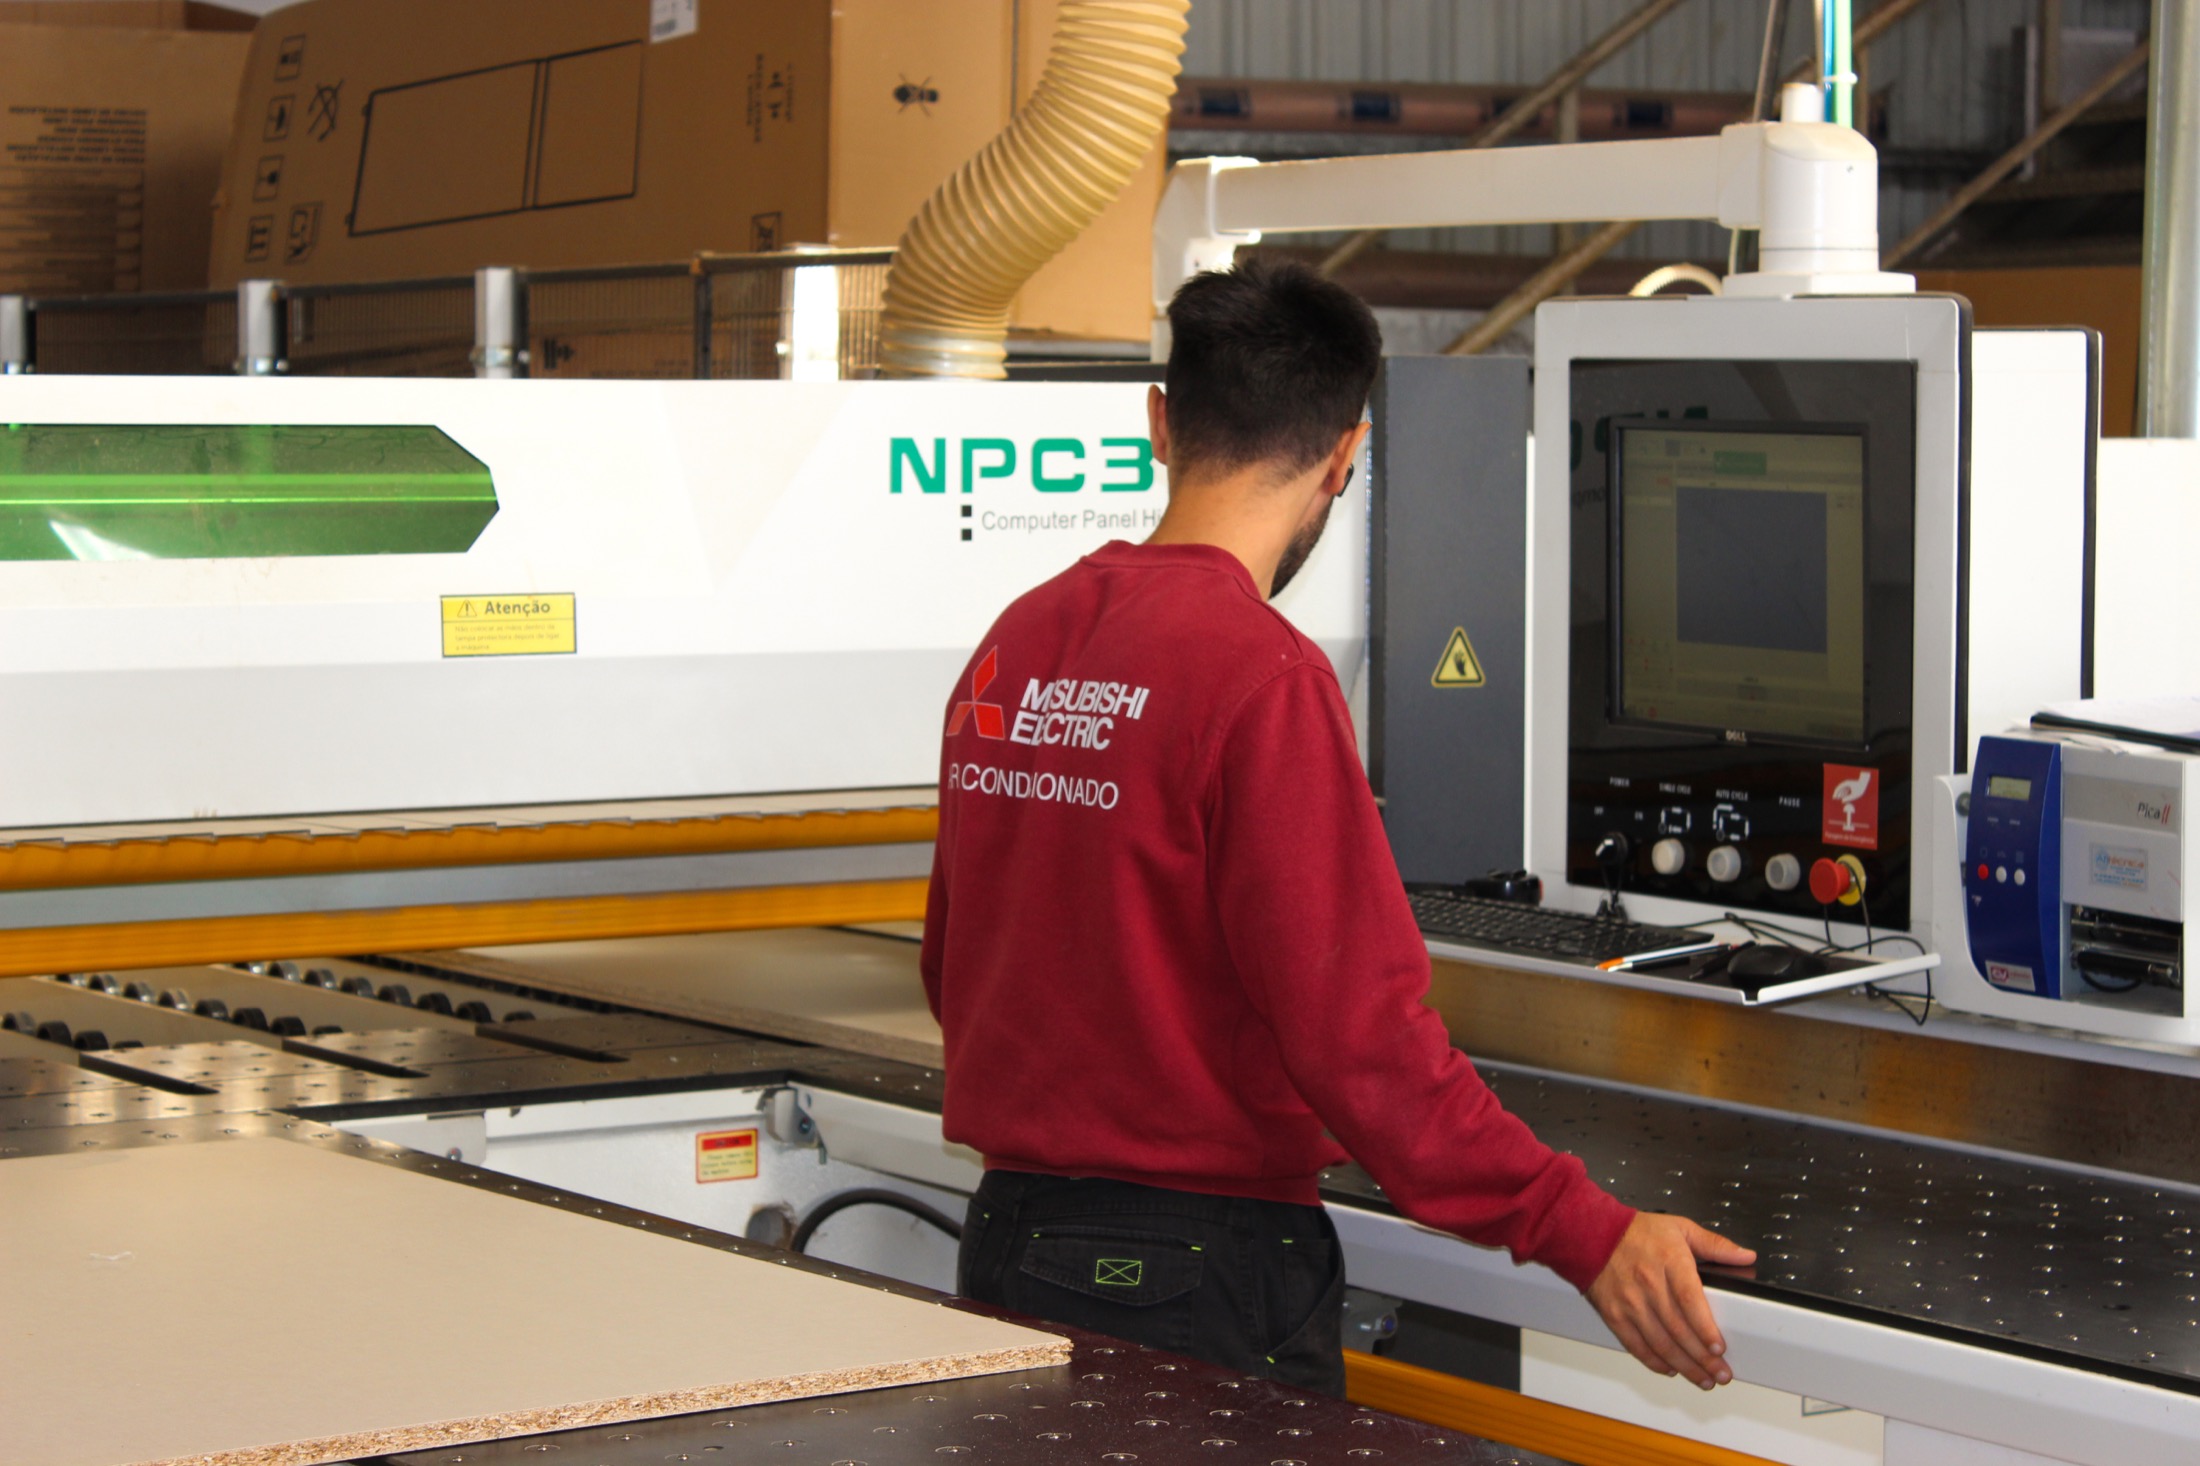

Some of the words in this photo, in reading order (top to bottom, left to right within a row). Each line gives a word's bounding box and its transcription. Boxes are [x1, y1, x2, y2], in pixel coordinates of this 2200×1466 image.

[981, 511, 1077, 534] Computer
[1082, 509, 1137, 528] Panel
[484, 600, 551, 617] Atenção
[1715, 789, 1729, 800] AUTO
[1779, 796, 1801, 808] PAUSE
